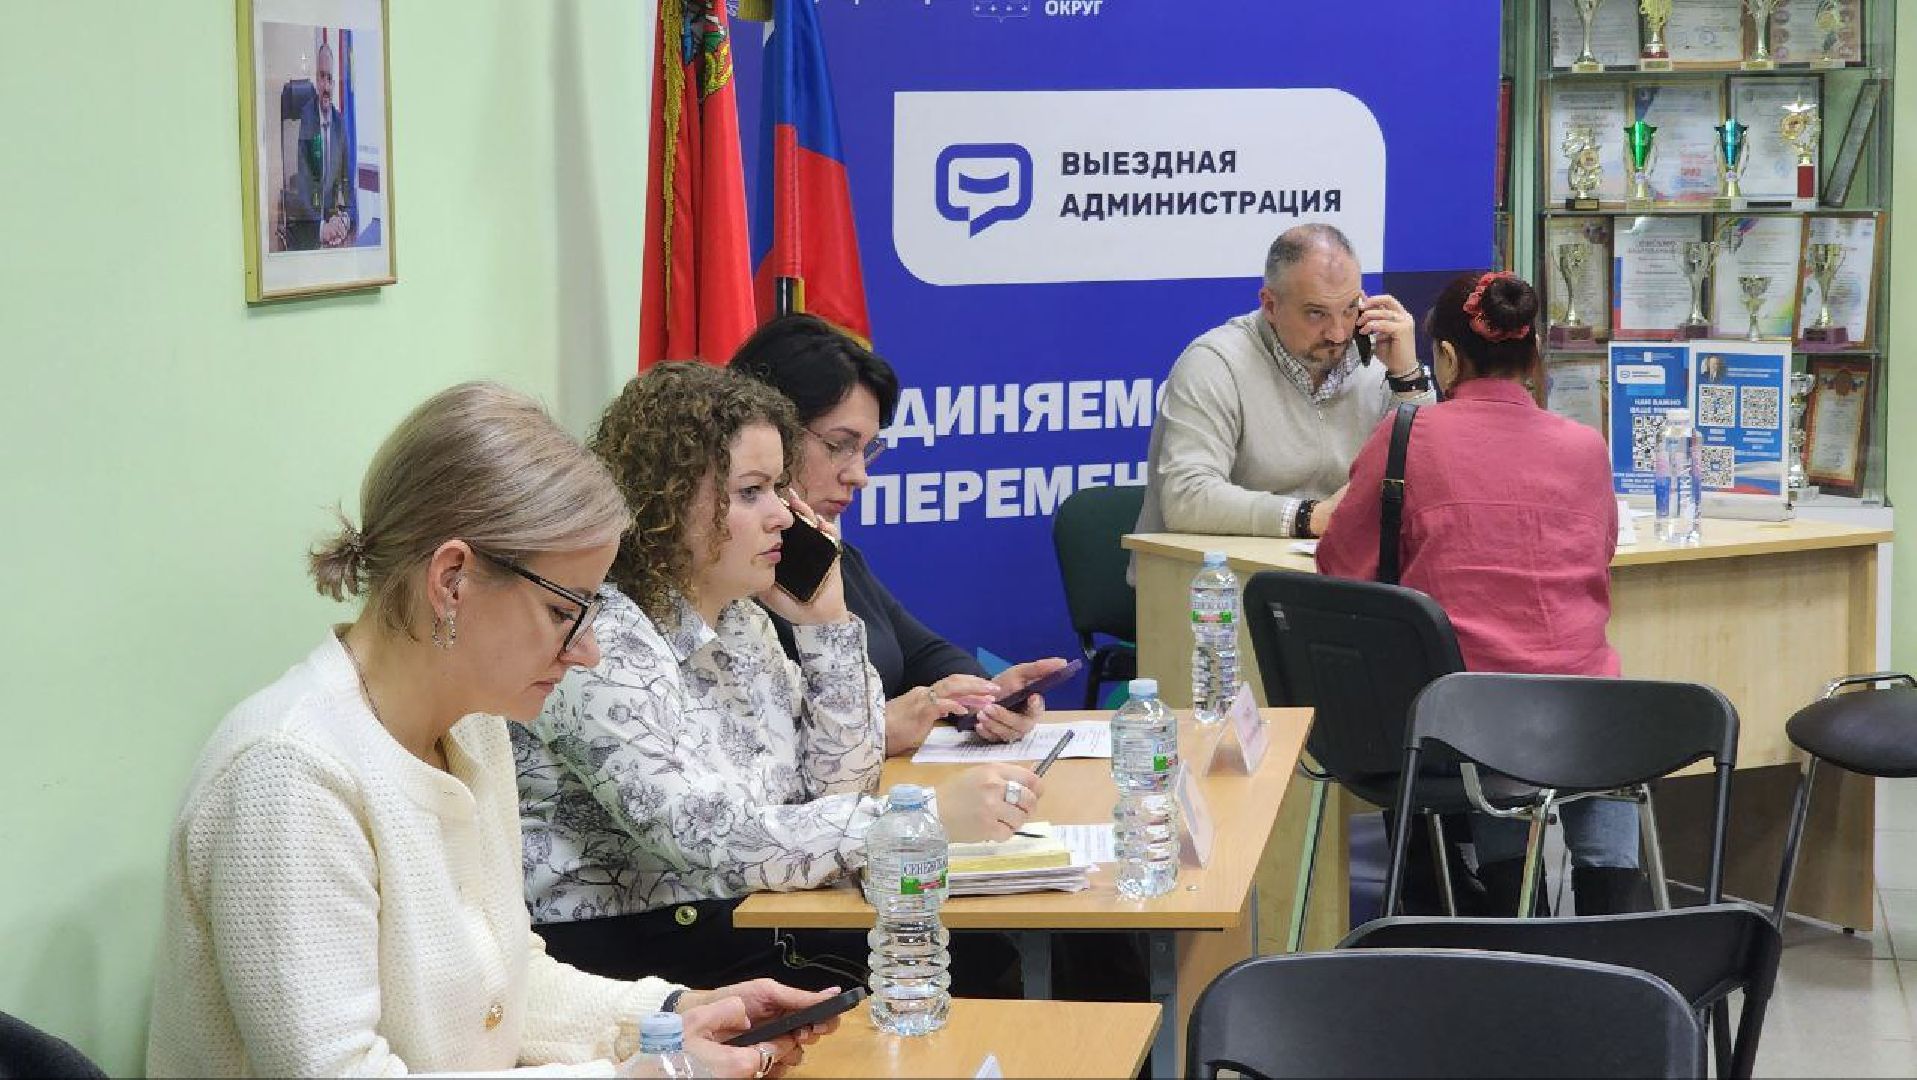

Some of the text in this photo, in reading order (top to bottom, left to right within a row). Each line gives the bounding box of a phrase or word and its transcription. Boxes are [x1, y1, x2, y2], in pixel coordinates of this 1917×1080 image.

[1045, 0, 1103, 16] ОКРУГ
[1061, 150, 1237, 179] ВЫЕЗДНАЯ
[1059, 189, 1342, 221] АДМИНИСТРАЦИЯ
[879, 378, 1166, 448] ДИНЯЕМ
